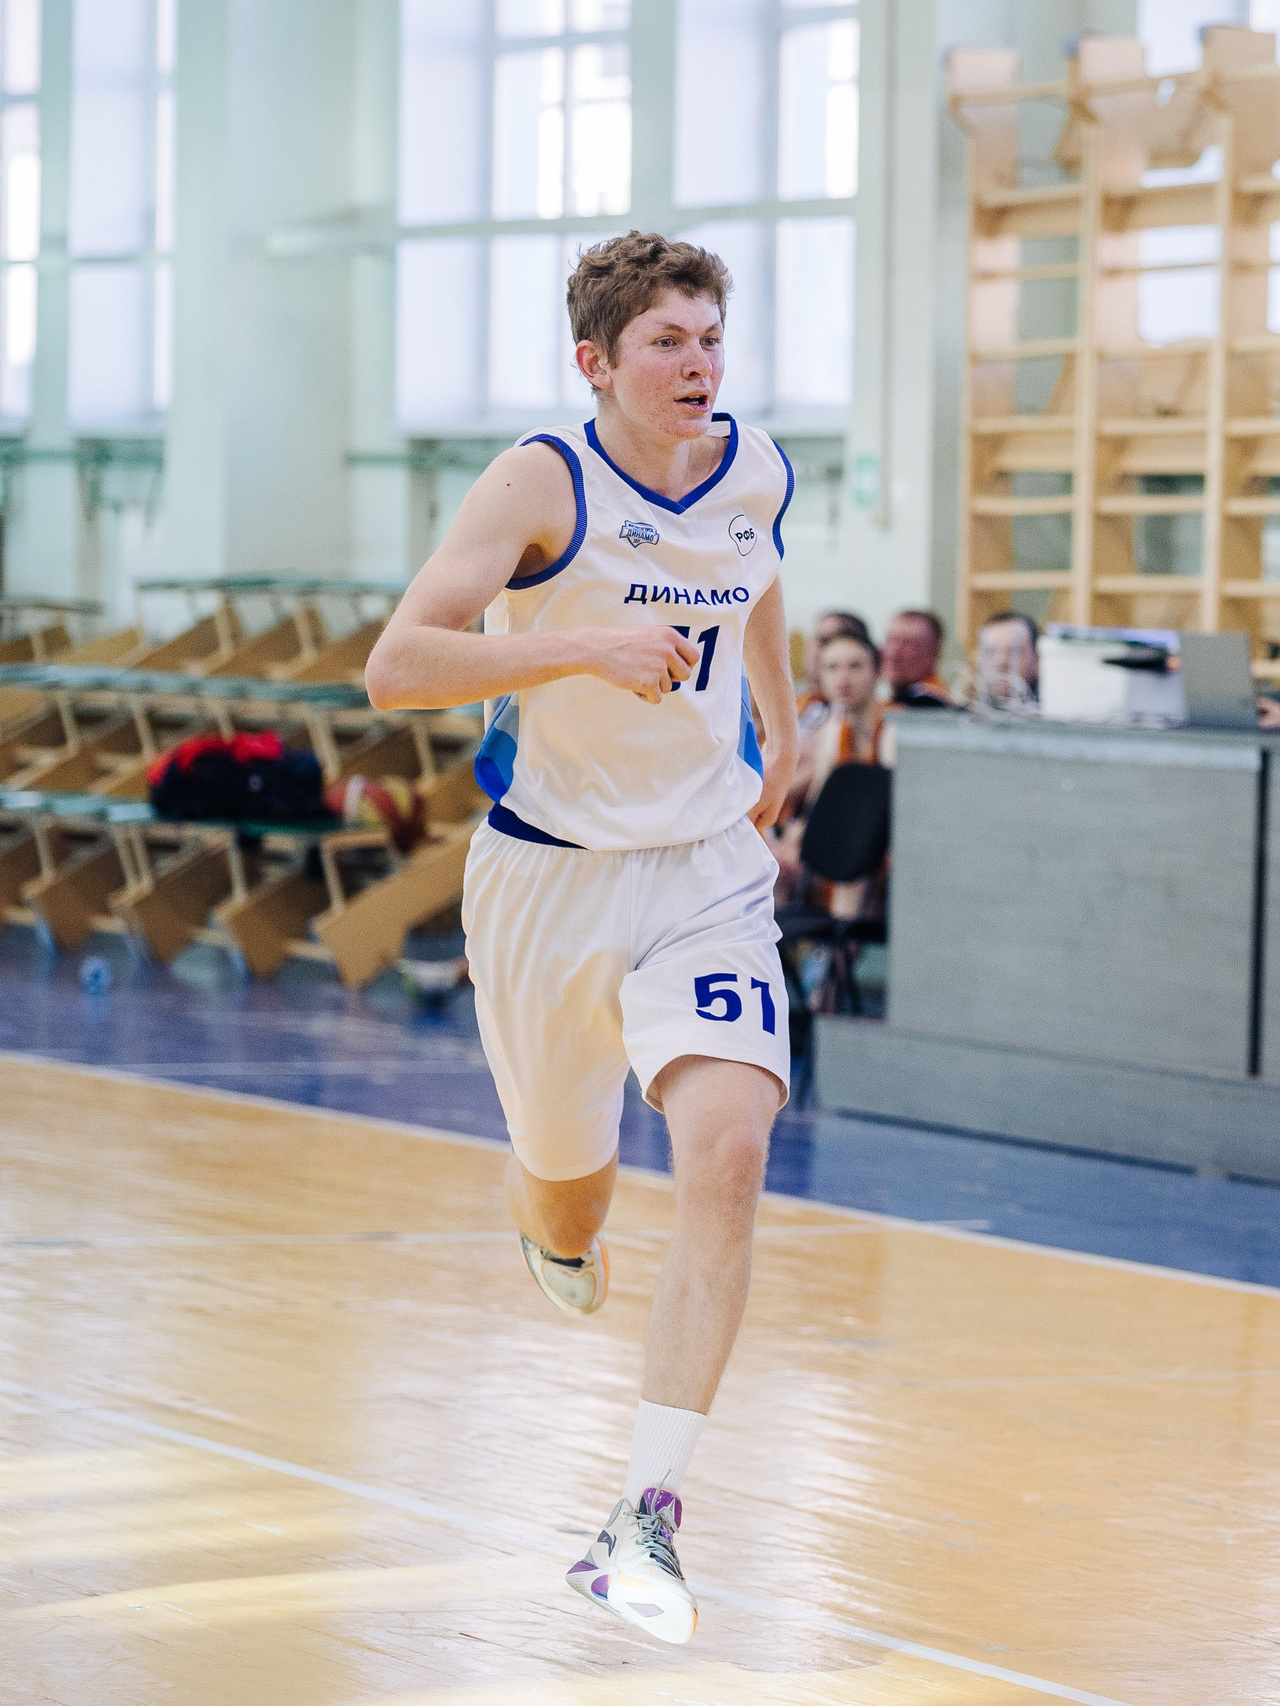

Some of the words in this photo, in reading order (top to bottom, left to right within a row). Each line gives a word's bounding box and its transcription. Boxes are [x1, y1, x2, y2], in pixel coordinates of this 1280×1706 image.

[735, 528, 755, 543] РФБ
[624, 583, 750, 606] ДИНАМО
[657, 625, 720, 692] 1
[694, 972, 776, 1036] 51
